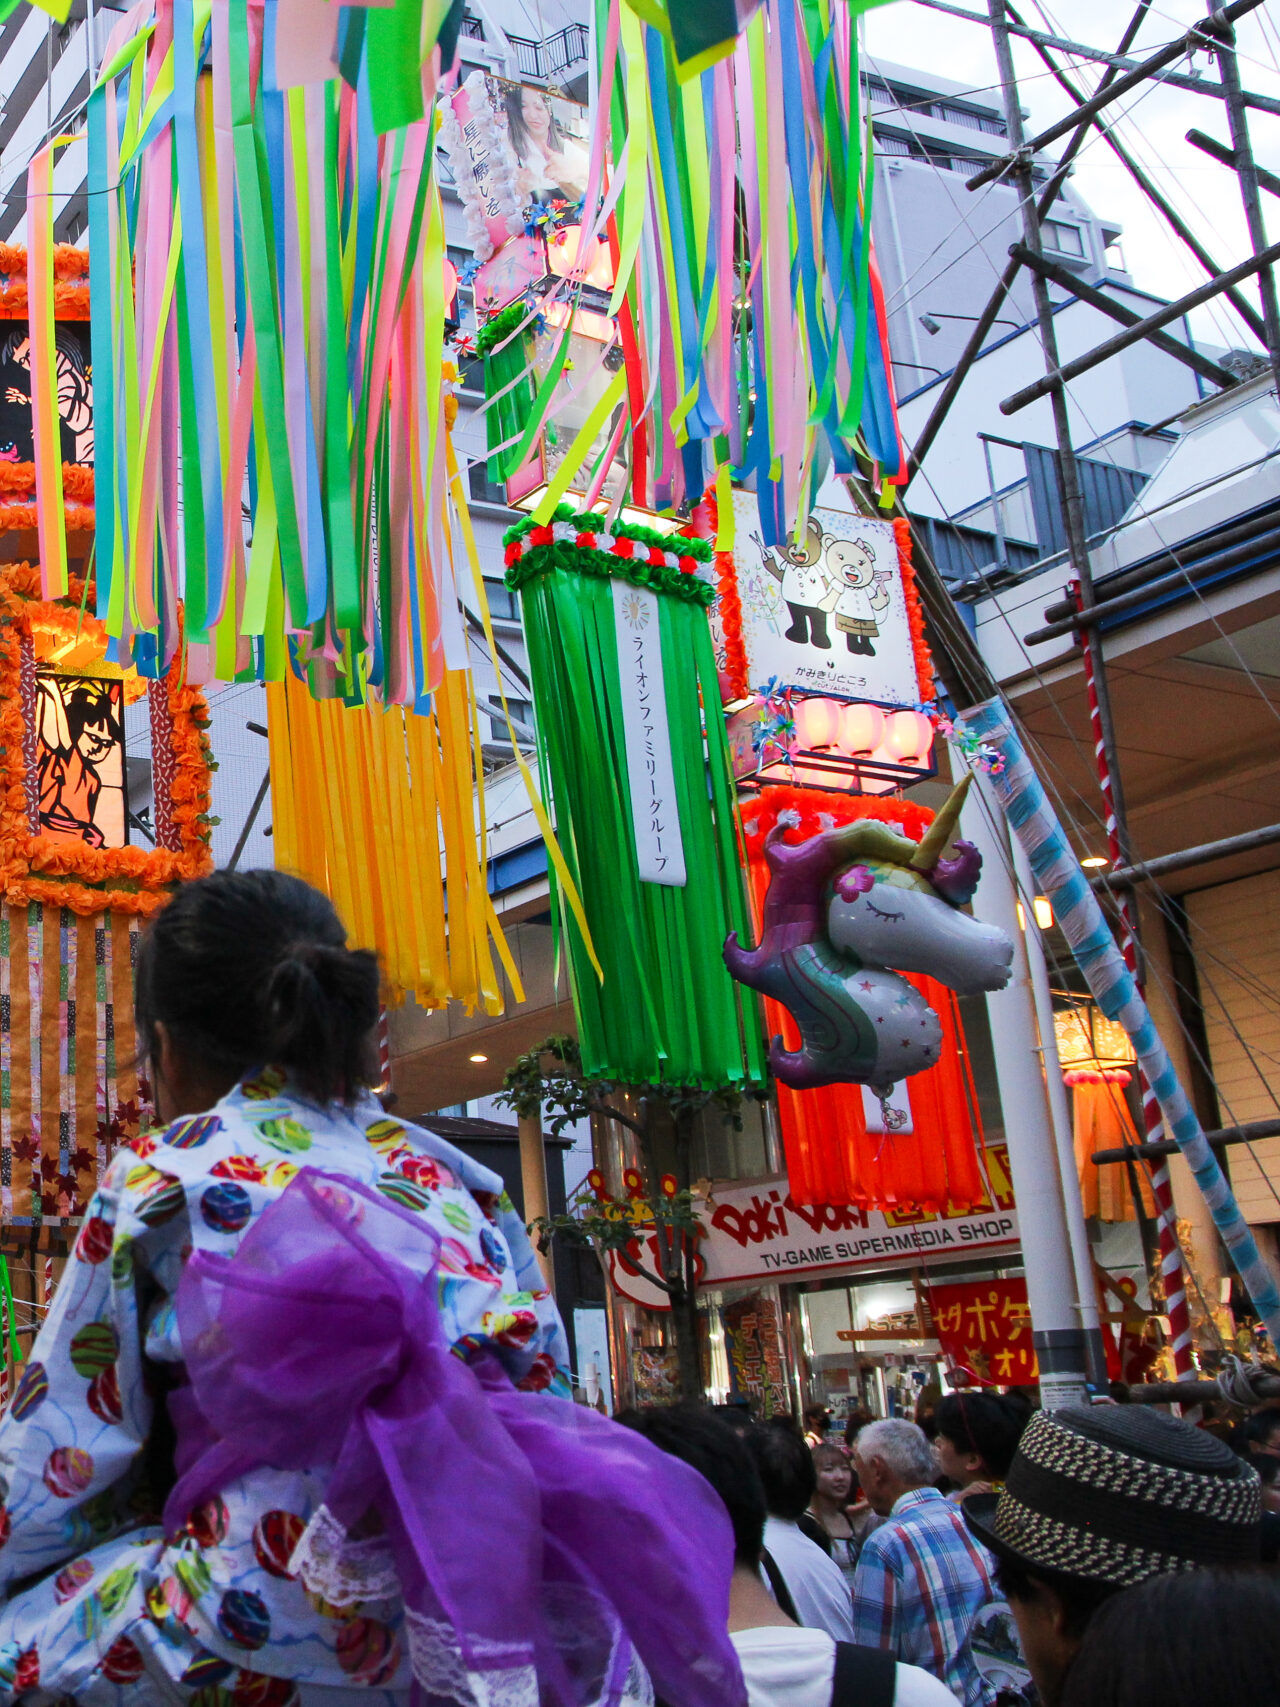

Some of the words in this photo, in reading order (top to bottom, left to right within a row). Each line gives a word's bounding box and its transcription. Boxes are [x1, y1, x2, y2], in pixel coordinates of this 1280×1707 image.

[795, 667, 867, 687] かみきりところ
[632, 636, 670, 874] ライオンファミリーグループ
[760, 1245, 834, 1268] TV-GAME
[836, 1227, 954, 1258] SUPERMEDIA
[958, 1218, 1013, 1241] SHOP
